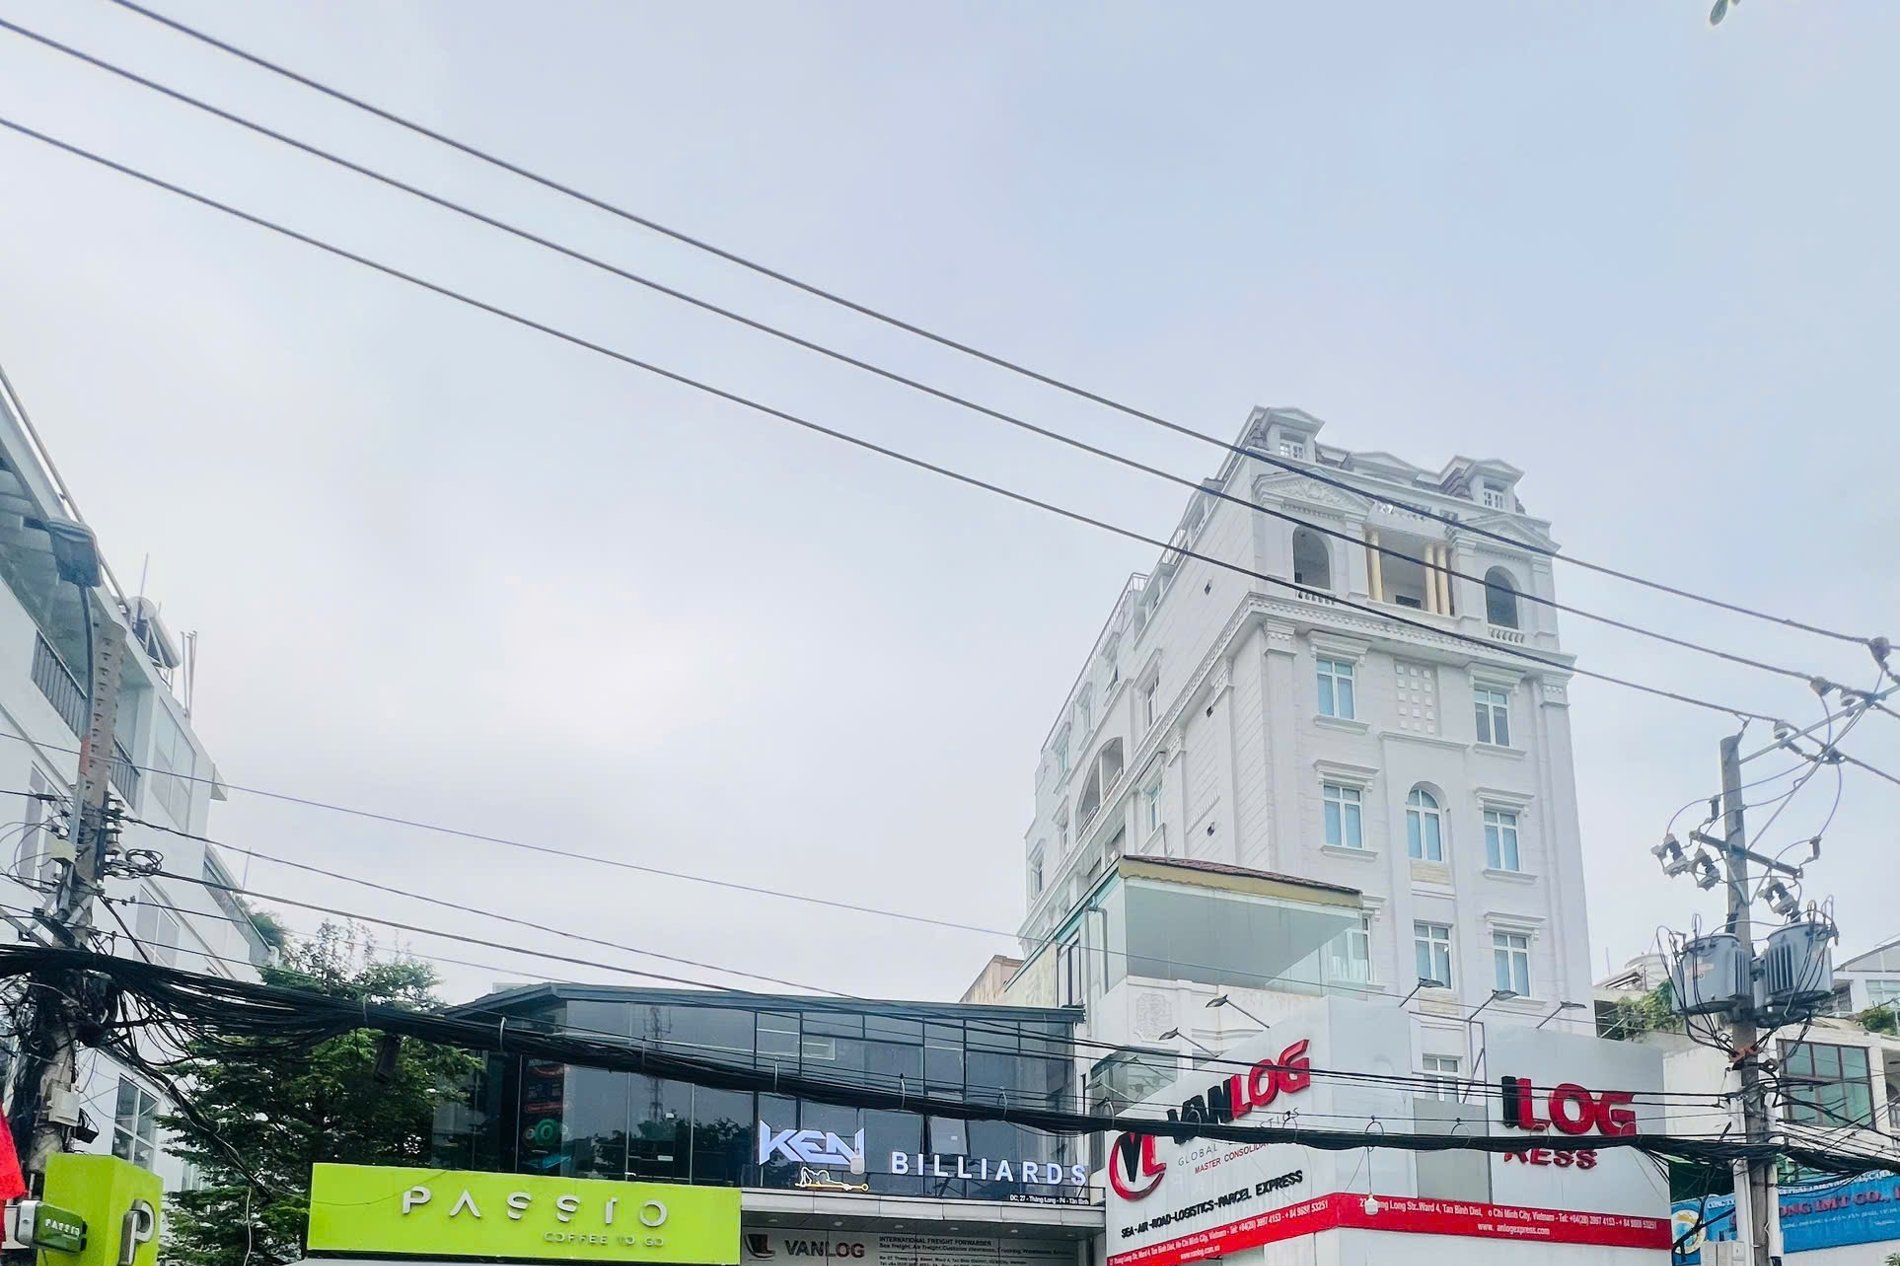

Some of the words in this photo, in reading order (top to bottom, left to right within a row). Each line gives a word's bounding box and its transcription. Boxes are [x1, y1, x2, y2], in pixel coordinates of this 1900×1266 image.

[758, 1119, 865, 1168] KEN
[891, 1151, 1087, 1186] BILLIARDS
[1178, 1142, 1220, 1167] GLOBAL
[1195, 1157, 1222, 1174] MASTER
[1255, 1169, 1303, 1197] EXPRESS
[402, 1186, 668, 1227] PASSIO
[1390, 1200, 1406, 1212] Long
[1442, 1203, 1454, 1214] Tan
[1454, 1204, 1468, 1215] Binh
[1493, 1208, 1503, 1218] Chi
[1504, 1208, 1519, 1219] Minh
[1518, 1209, 1532, 1222] City,
[1532, 1210, 1555, 1222] Vietnam
[544, 1231, 608, 1246] COFFEE
[617, 1235, 636, 1246] TO
[644, 1236, 664, 1247] GO
[784, 1238, 866, 1259] VANLOG
